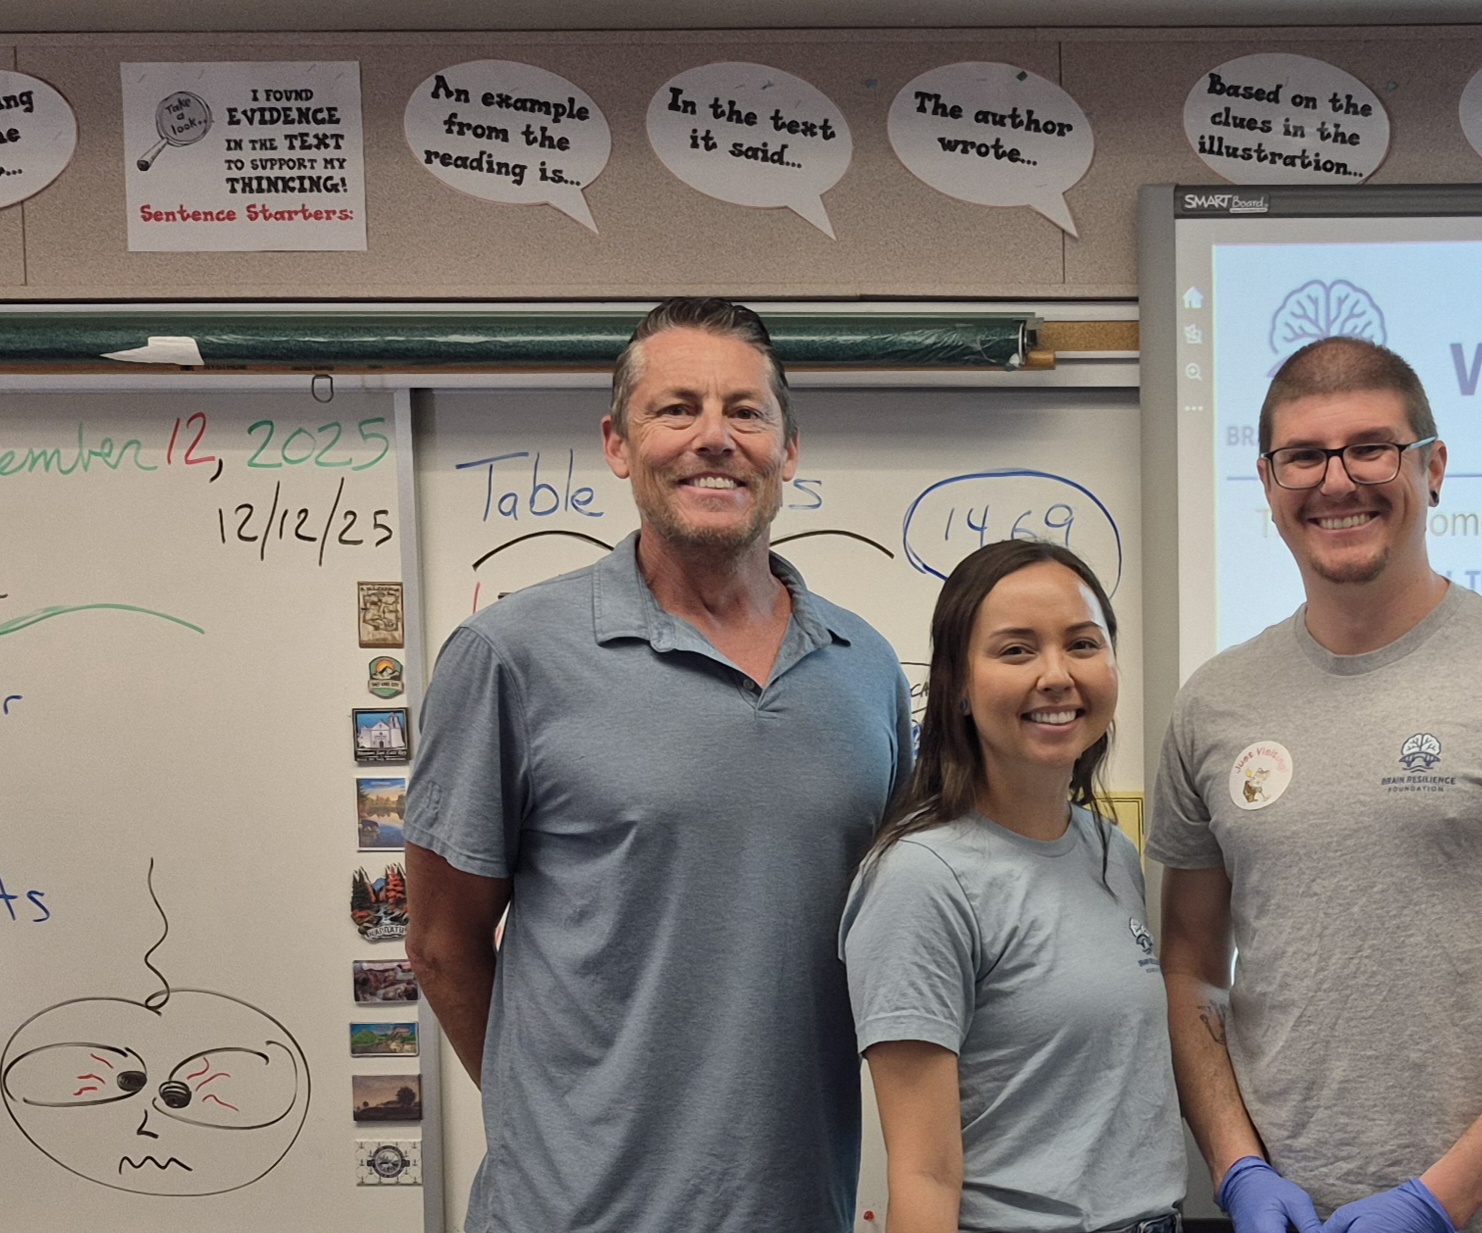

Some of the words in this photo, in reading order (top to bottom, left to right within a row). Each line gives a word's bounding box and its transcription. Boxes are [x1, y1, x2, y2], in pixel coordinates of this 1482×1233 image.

[251, 89, 260, 101] I
[264, 89, 313, 101] FOUND
[431, 76, 470, 104] An
[481, 88, 590, 122] example
[668, 87, 698, 115] In
[709, 97, 758, 127] the
[770, 109, 836, 141] text
[914, 91, 963, 119] The
[974, 107, 1073, 137] author
[1207, 73, 1282, 105] Based
[1291, 91, 1318, 111] on
[1328, 93, 1373, 118] the
[227, 107, 341, 126] EVIDENCE
[444, 113, 509, 141] from
[521, 123, 571, 151] the
[1210, 109, 1272, 134] clues
[1283, 119, 1306, 139] in
[1317, 122, 1361, 146] the
[225, 138, 244, 151] IN
[248, 138, 278, 151] THE
[284, 132, 344, 151] TEXT
[690, 129, 717, 152] it
[729, 140, 802, 169] said...
[937, 136, 1038, 166] wrote...
[1198, 135, 1364, 178] illustration...
[225, 159, 244, 171] TO
[250, 157, 316, 171] SUPPORT
[323, 157, 347, 170] MY
[423, 148, 527, 185] reading
[539, 162, 581, 186] is...
[226, 175, 348, 194] THINKING!
[1185, 195, 1232, 209] SMART
[1232, 196, 1264, 208] Board
[140, 203, 236, 223] Sentence
[247, 203, 355, 222] Starters:
[167, 412, 224, 483] 12,
[247, 418, 390, 471] 2025
[456, 449, 605, 522] Table
[219, 477, 394, 567] 12/12/25
[1381, 776, 1404, 785] BRAIN
[1407, 776, 1456, 785] RESILIENCE
